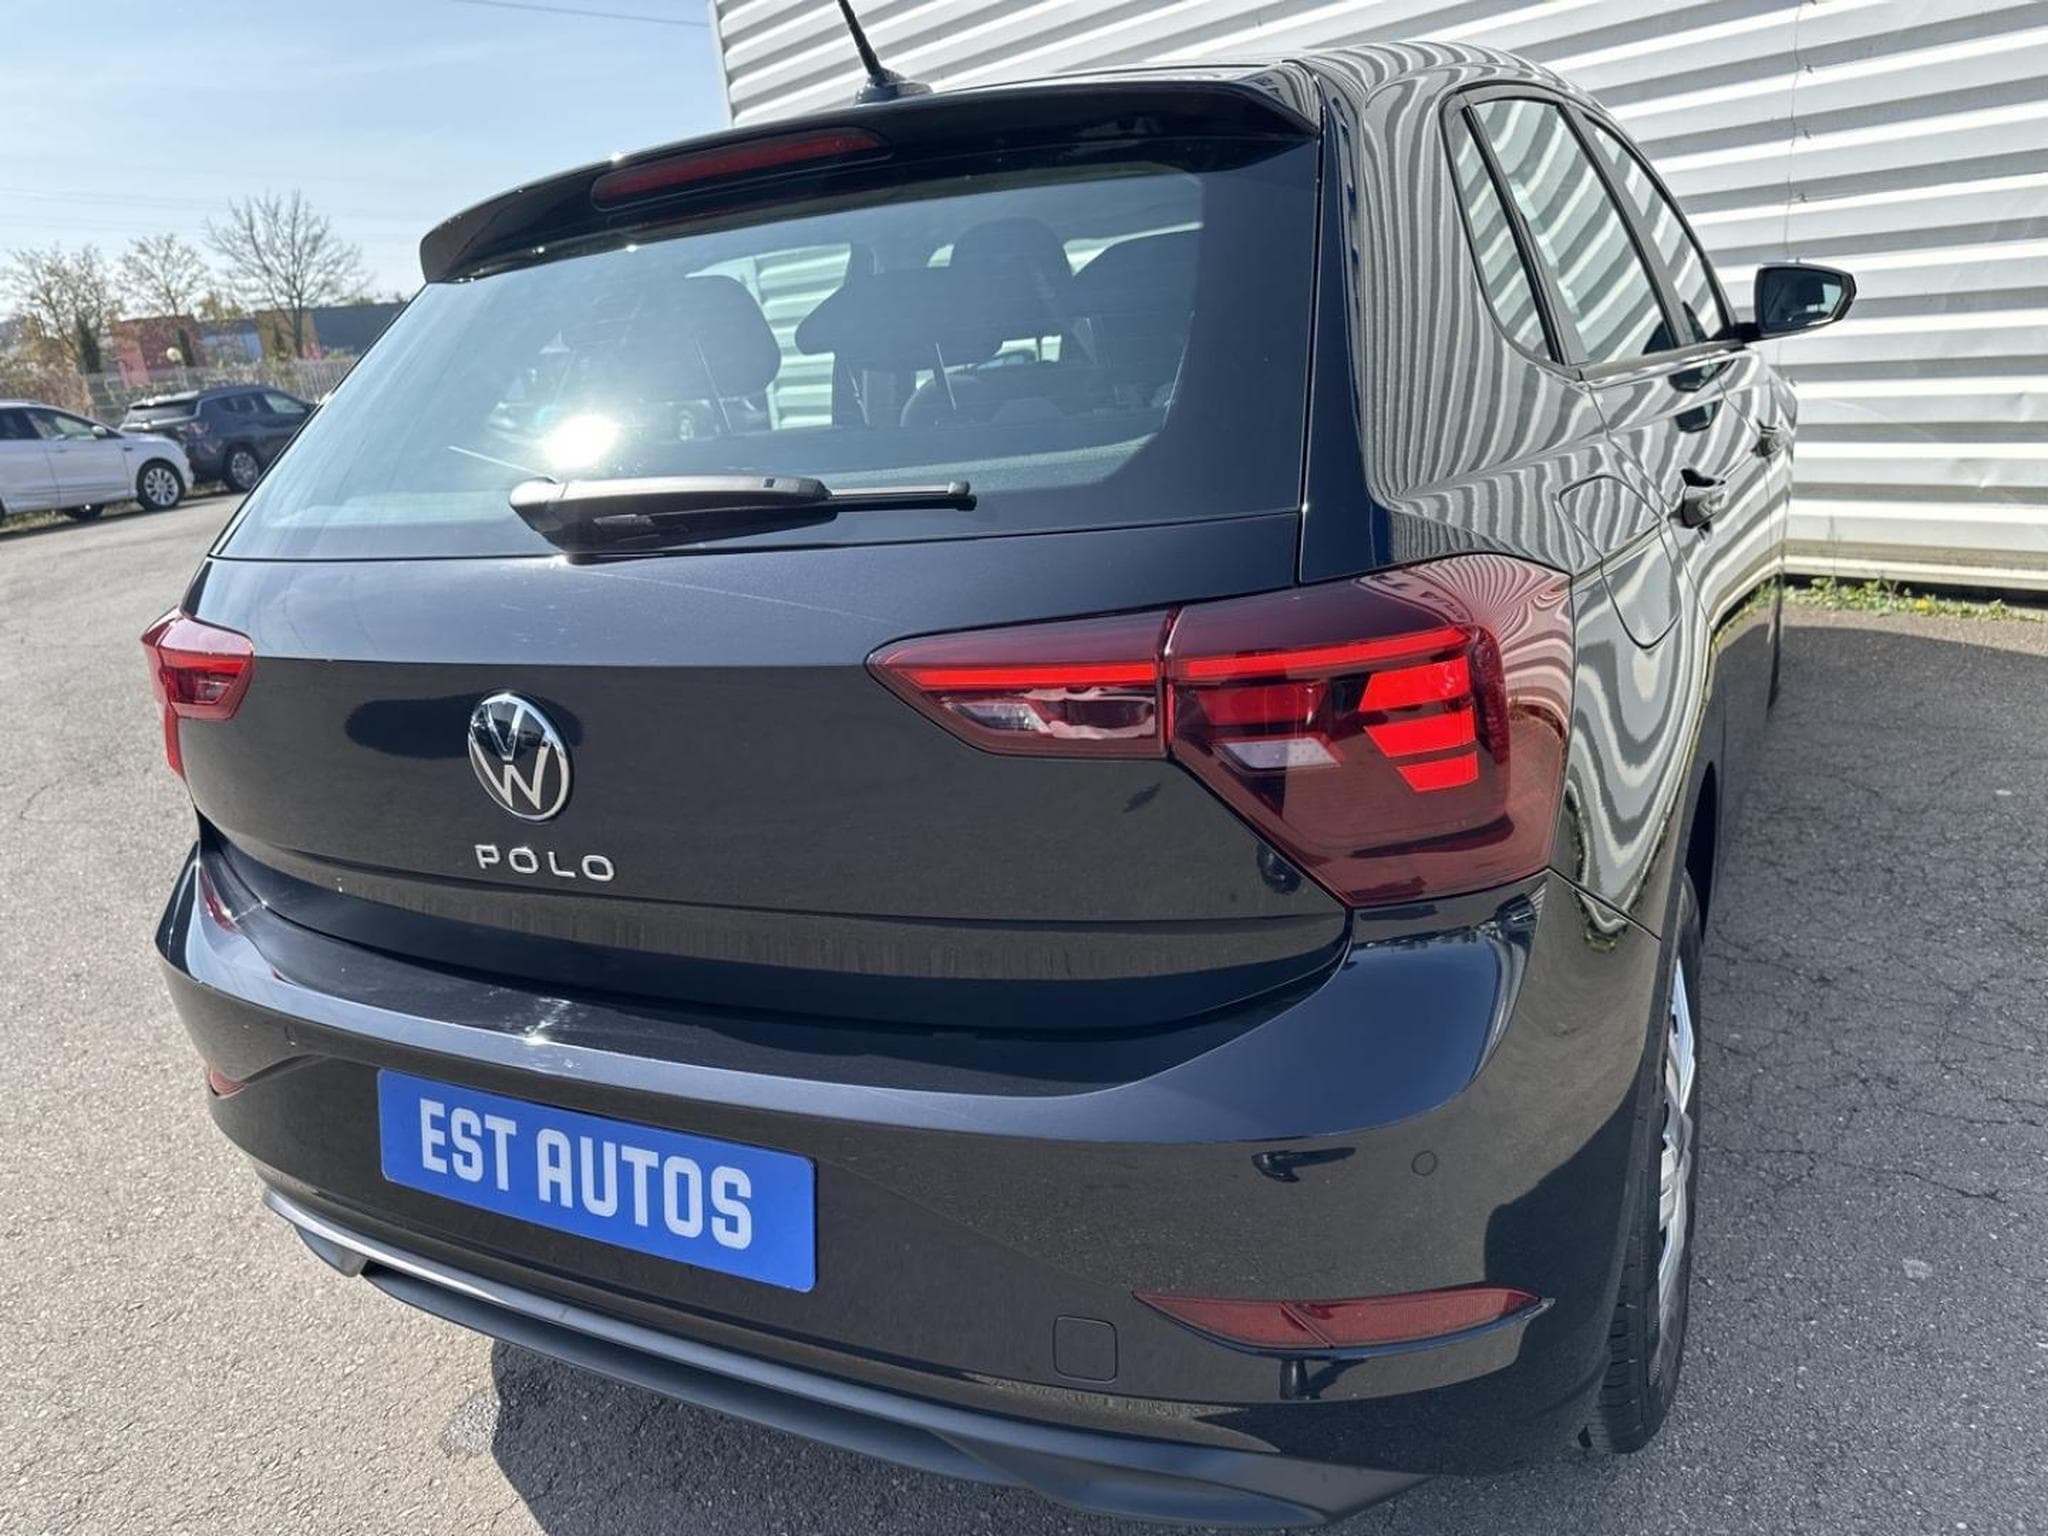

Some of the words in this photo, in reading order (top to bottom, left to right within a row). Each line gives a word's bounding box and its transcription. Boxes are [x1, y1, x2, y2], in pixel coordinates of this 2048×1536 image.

[474, 844, 615, 881] POLO
[420, 1098, 517, 1191] EST
[536, 1128, 752, 1250] AUTOS
